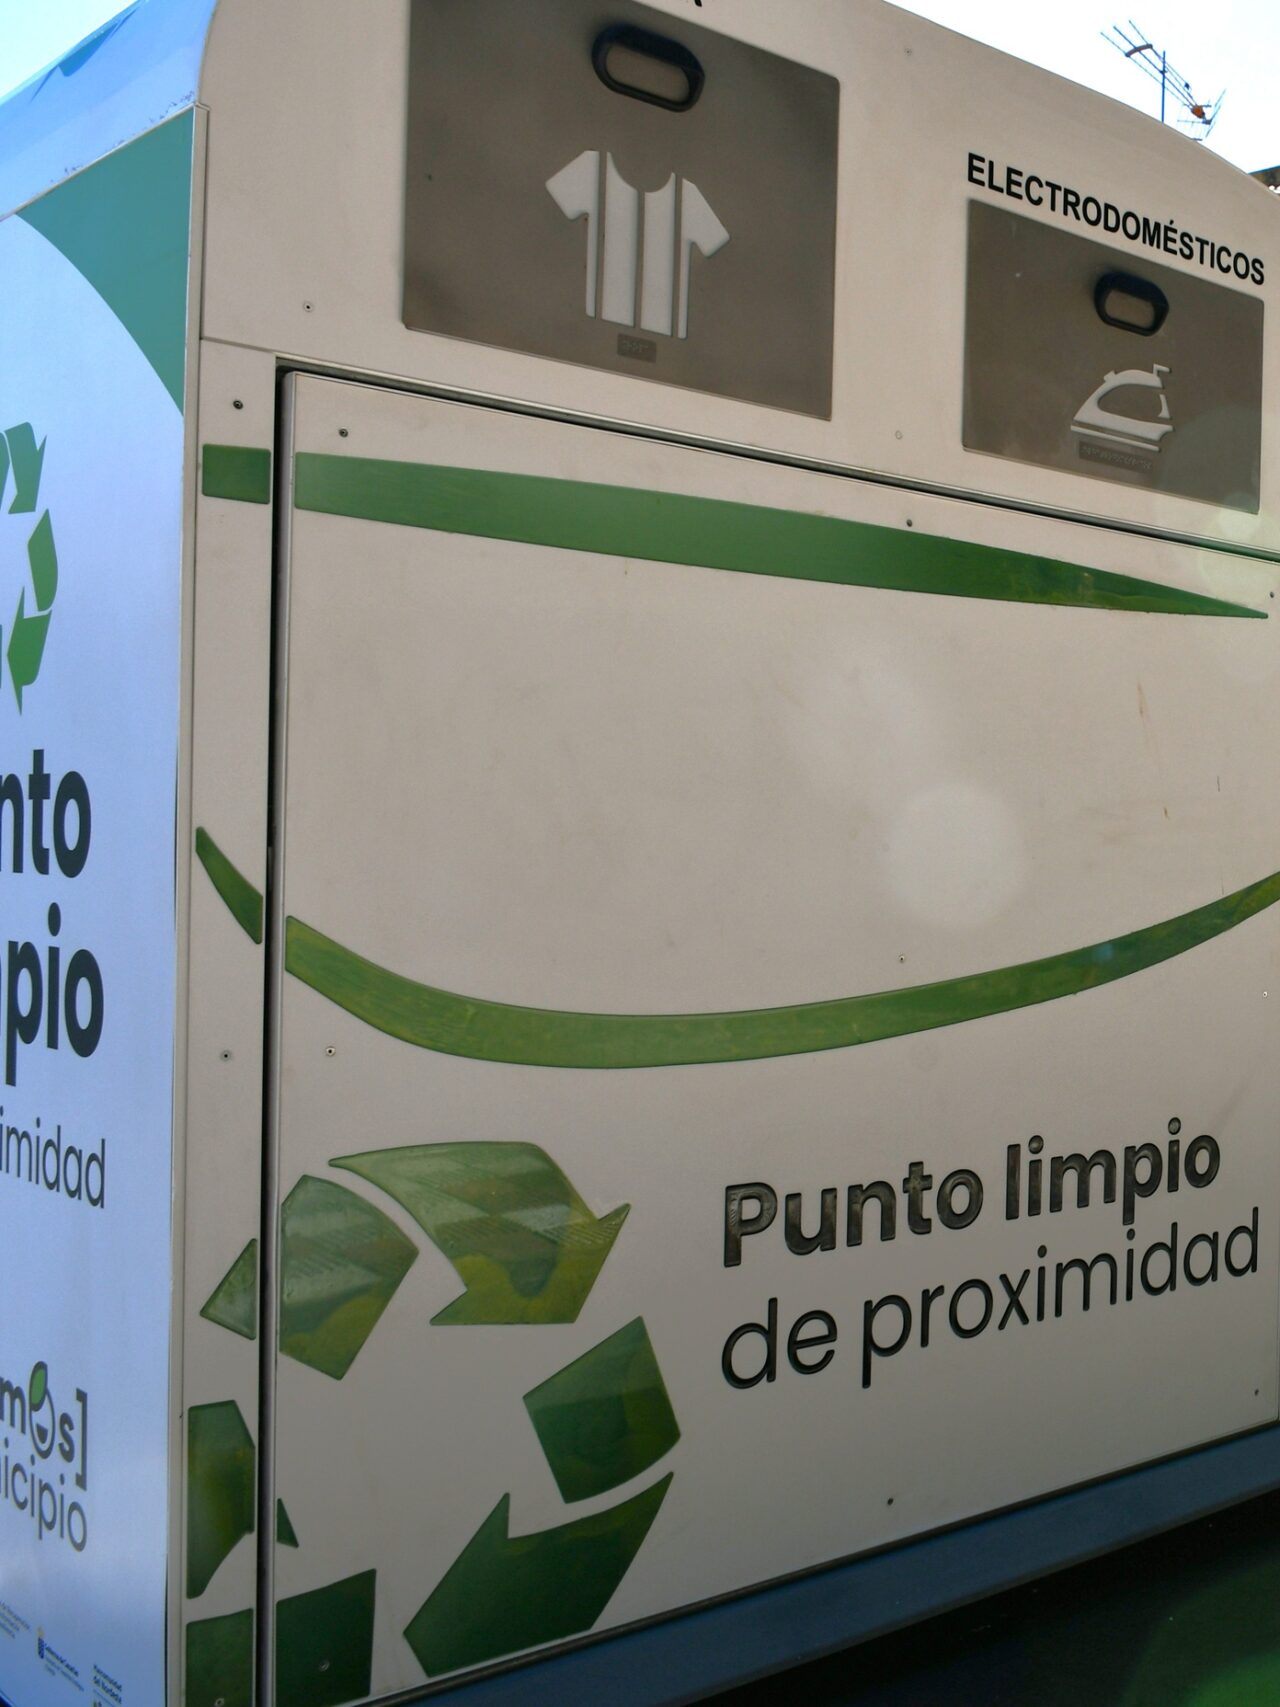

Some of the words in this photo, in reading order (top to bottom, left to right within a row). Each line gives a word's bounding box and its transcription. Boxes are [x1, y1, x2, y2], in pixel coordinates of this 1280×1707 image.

[968, 153, 1265, 285] ELECTRODOMÉSTICOS
[723, 1160, 984, 1267] Punto
[1004, 1116, 1221, 1226] limpio
[721, 1297, 838, 1389] de
[861, 1206, 1259, 1388] proximidad
